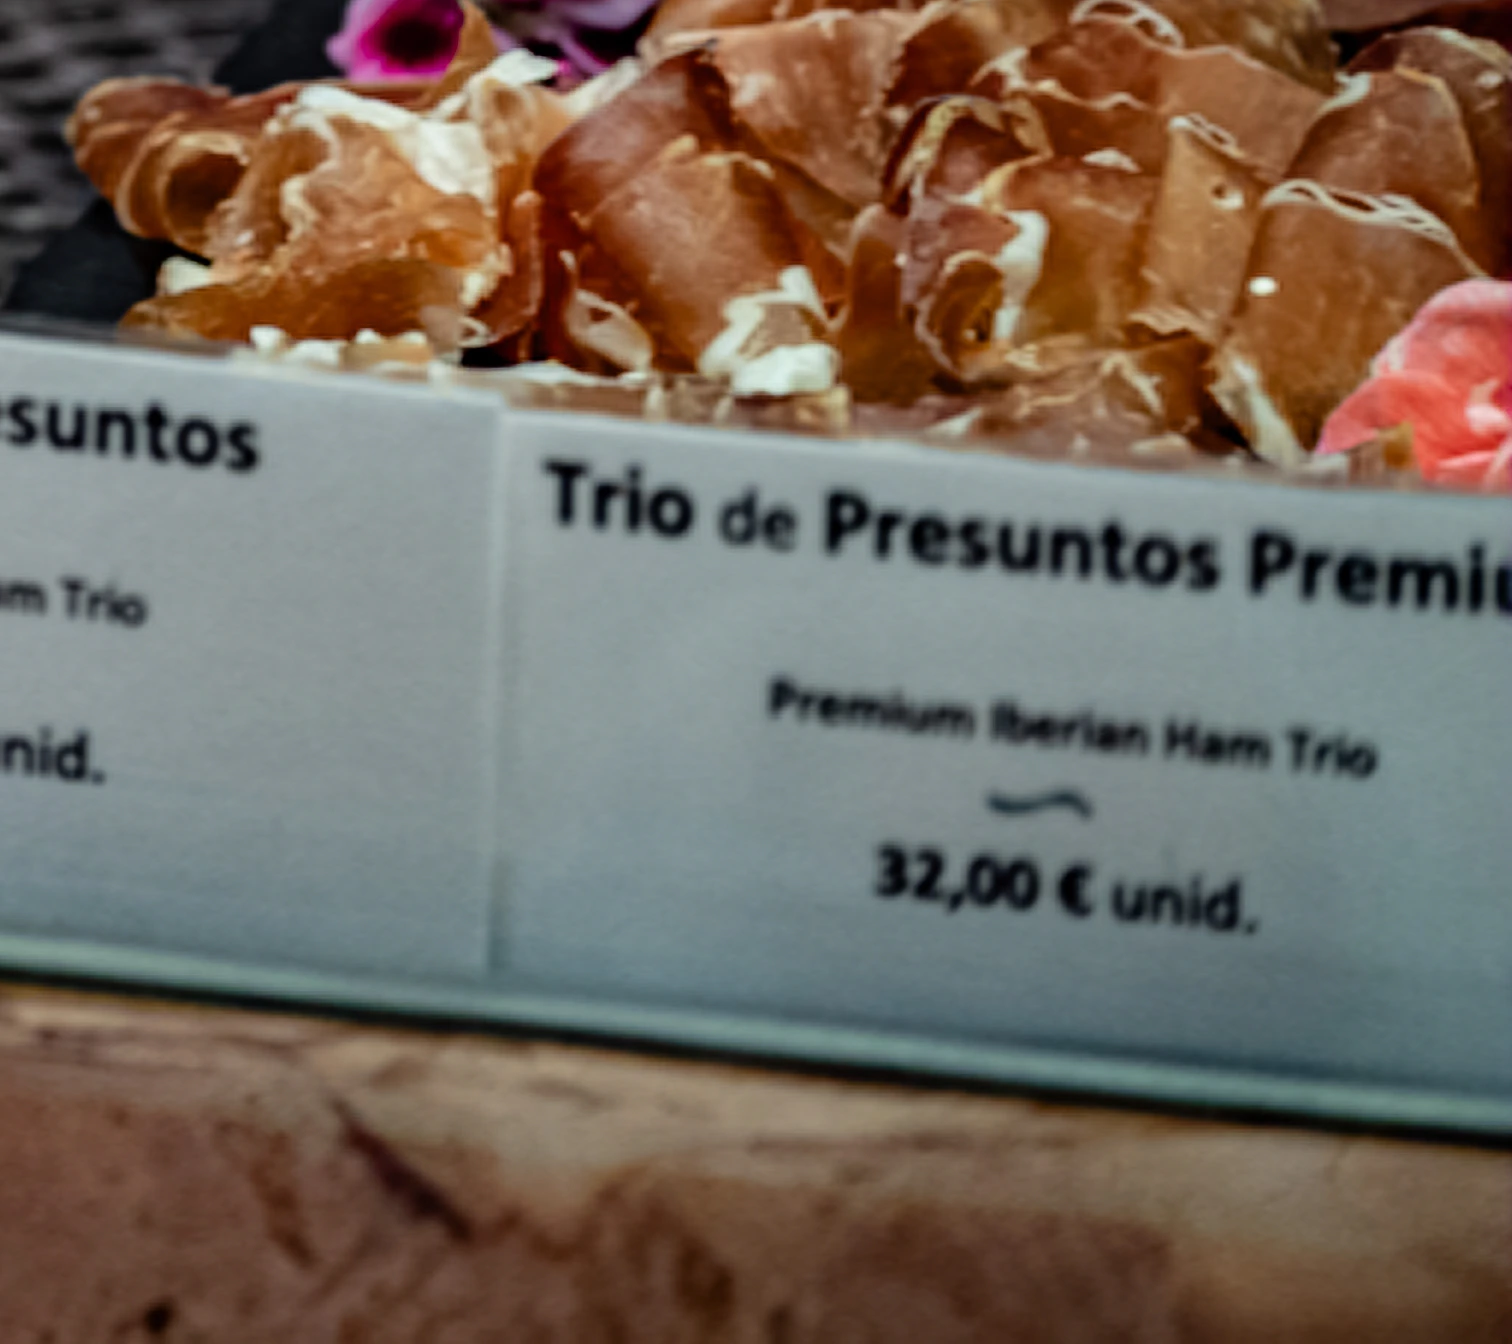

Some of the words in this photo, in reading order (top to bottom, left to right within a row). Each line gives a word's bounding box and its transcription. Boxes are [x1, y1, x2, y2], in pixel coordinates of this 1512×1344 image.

[544, 458, 695, 539] Trio
[718, 489, 798, 551] de
[823, 488, 1222, 593] Presuntos
[60, 577, 148, 628] Trio
[767, 677, 977, 736] Premium
[990, 702, 1151, 754] Iberian
[1164, 721, 1272, 766] Ham
[1287, 728, 1378, 779] Trio
[876, 844, 1042, 913] 32,00
[1056, 864, 1092, 918] €
[1110, 879, 1257, 935] unid.
